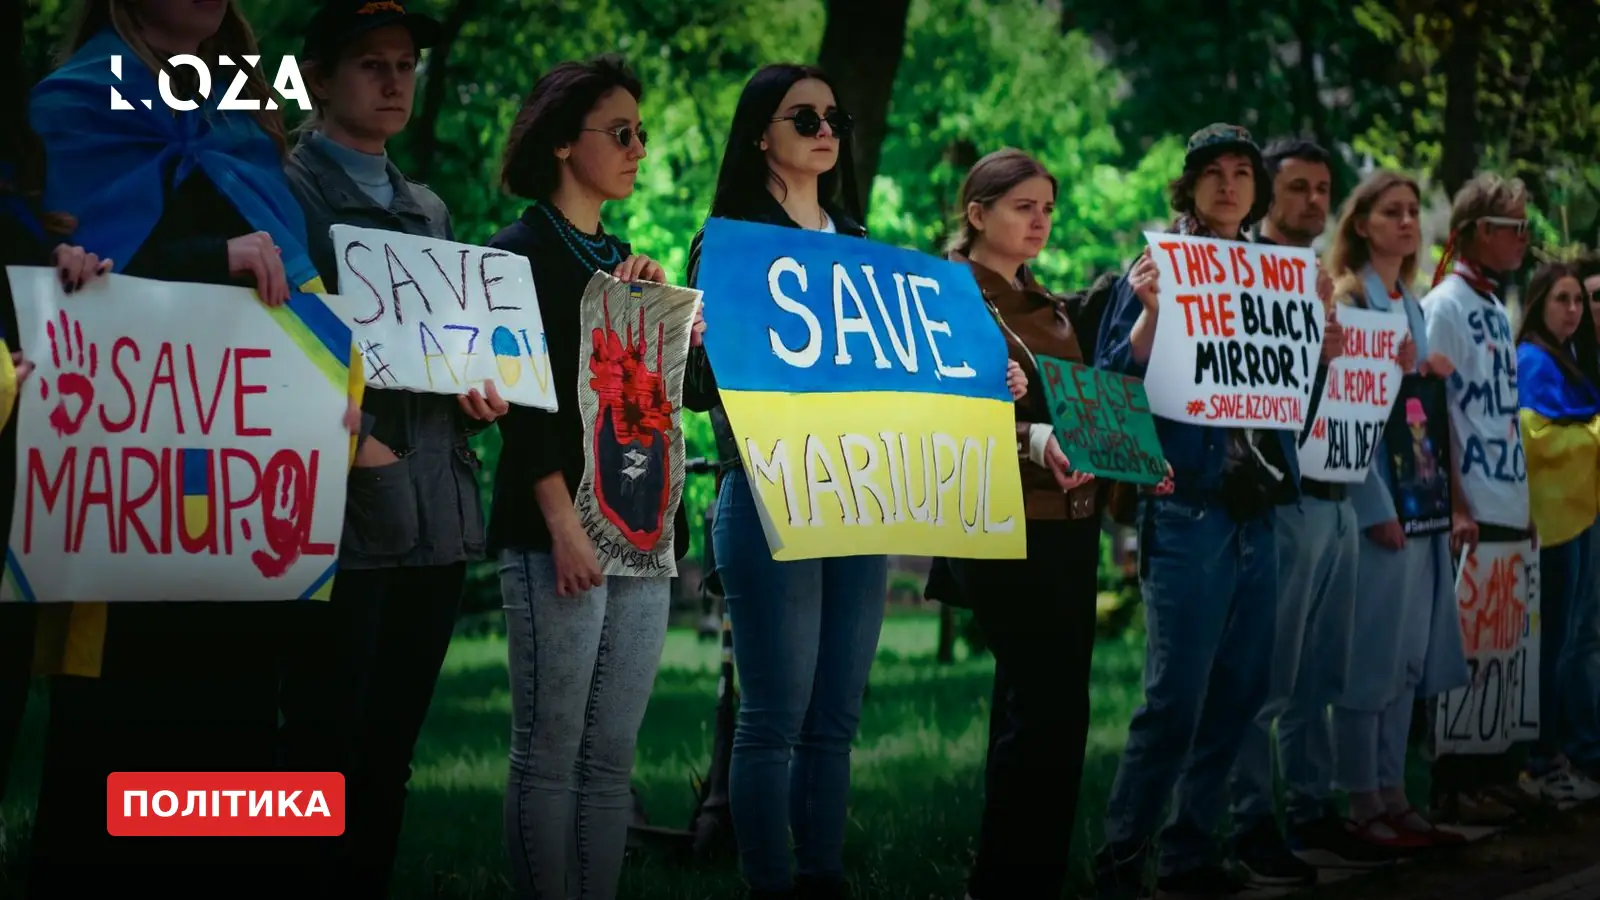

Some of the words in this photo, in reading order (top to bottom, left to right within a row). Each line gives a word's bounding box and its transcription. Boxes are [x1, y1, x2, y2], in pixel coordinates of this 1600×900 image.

[345, 241, 522, 326] SAVE
[1159, 242, 1226, 287] THIS
[1228, 246, 1255, 288] IS
[1259, 253, 1307, 294] NOT
[767, 256, 977, 380] SAVE
[1175, 293, 1236, 337] THE
[1240, 292, 1320, 344] BLACK
[99, 336, 272, 437] SAVE
[1043, 361, 1152, 414] PLEASE
[1194, 340, 1310, 395] MIRROR!
[1344, 369, 1388, 406] PEOPLE
[1186, 394, 1304, 424] #SAVEAZOVSTAL
[23, 447, 335, 557] MARIUPOL
[745, 431, 1015, 534] MARIUPOL
[1459, 552, 1525, 609] SAVE
